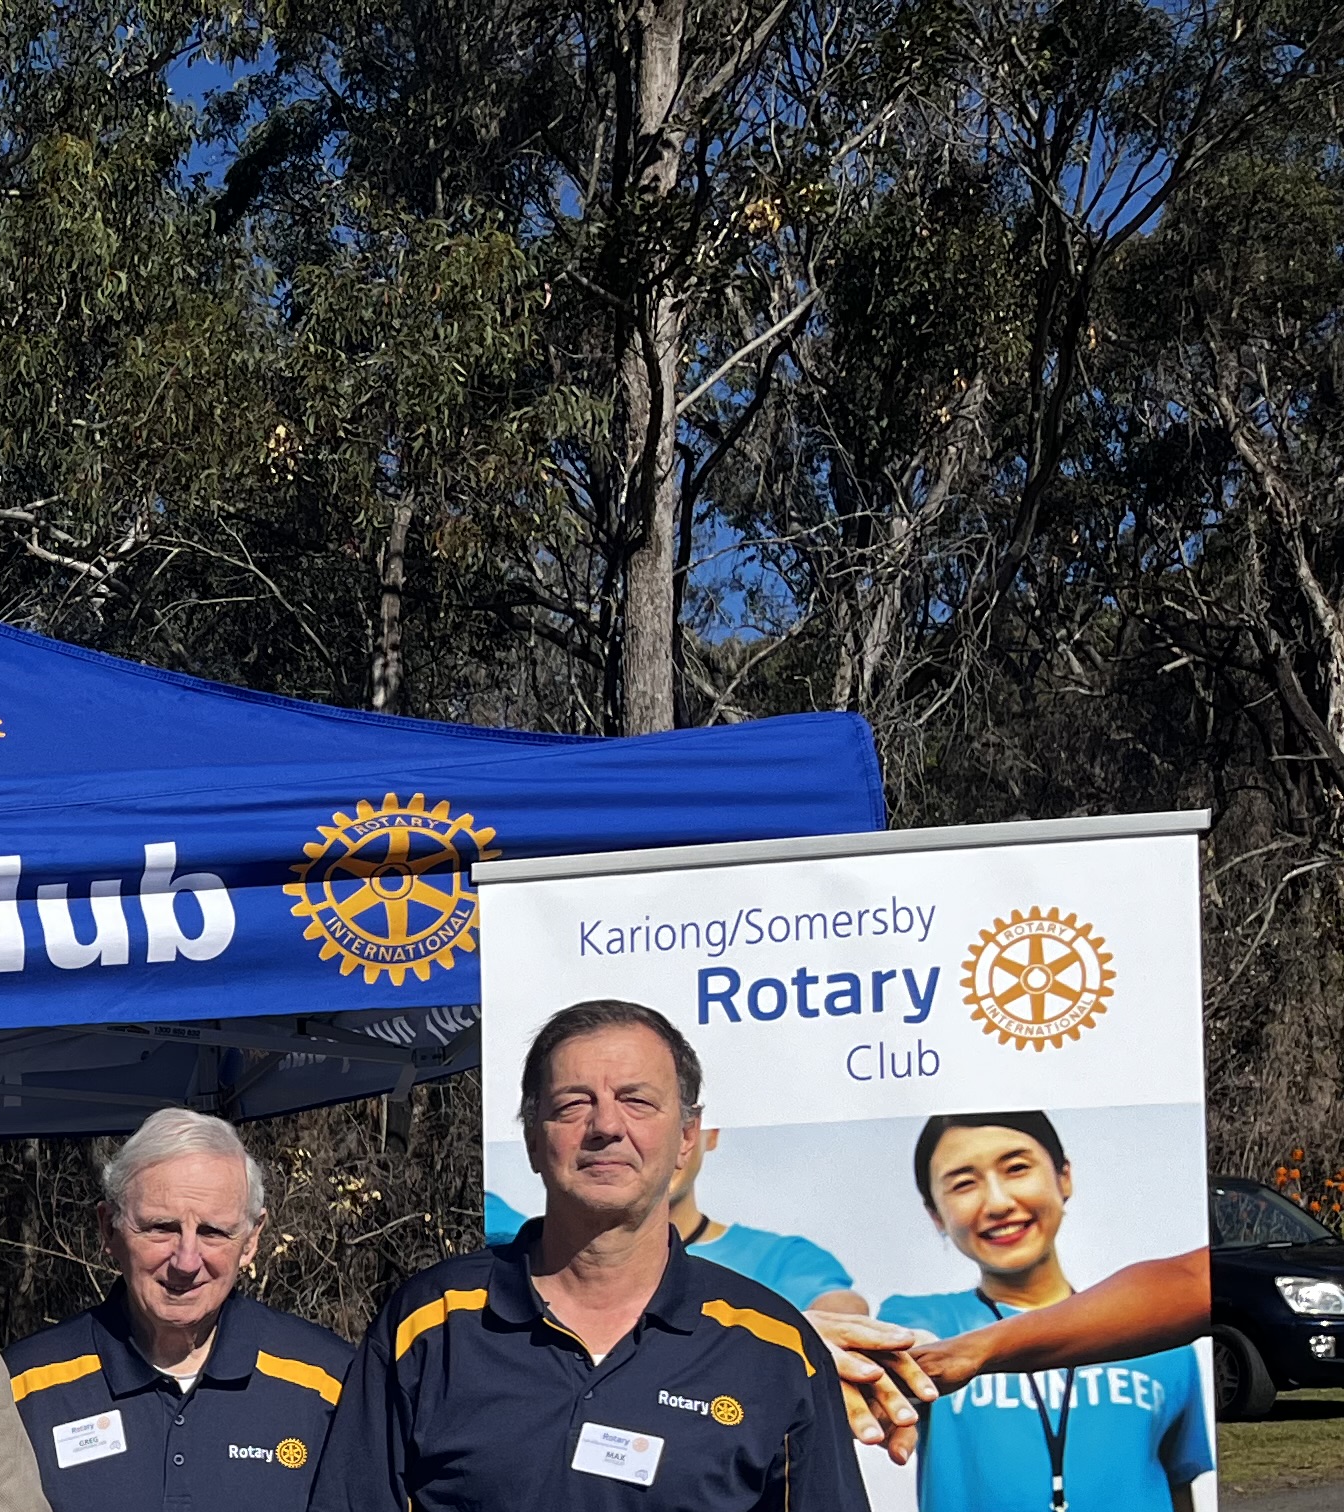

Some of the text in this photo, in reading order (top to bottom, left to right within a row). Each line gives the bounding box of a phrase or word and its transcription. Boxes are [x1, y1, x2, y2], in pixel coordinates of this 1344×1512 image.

[354, 815, 441, 836] ROTARY
[324, 908, 472, 962] INTERNATIONAL
[581, 896, 936, 957] Kariong/Somersby
[1003, 922, 1068, 941] ROTARY
[698, 965, 940, 1026] Rotary
[986, 998, 1094, 1037] INTERNATIONAL
[847, 1039, 939, 1081] Club
[658, 1389, 709, 1416] Rotary
[228, 1444, 274, 1463] Rotary
